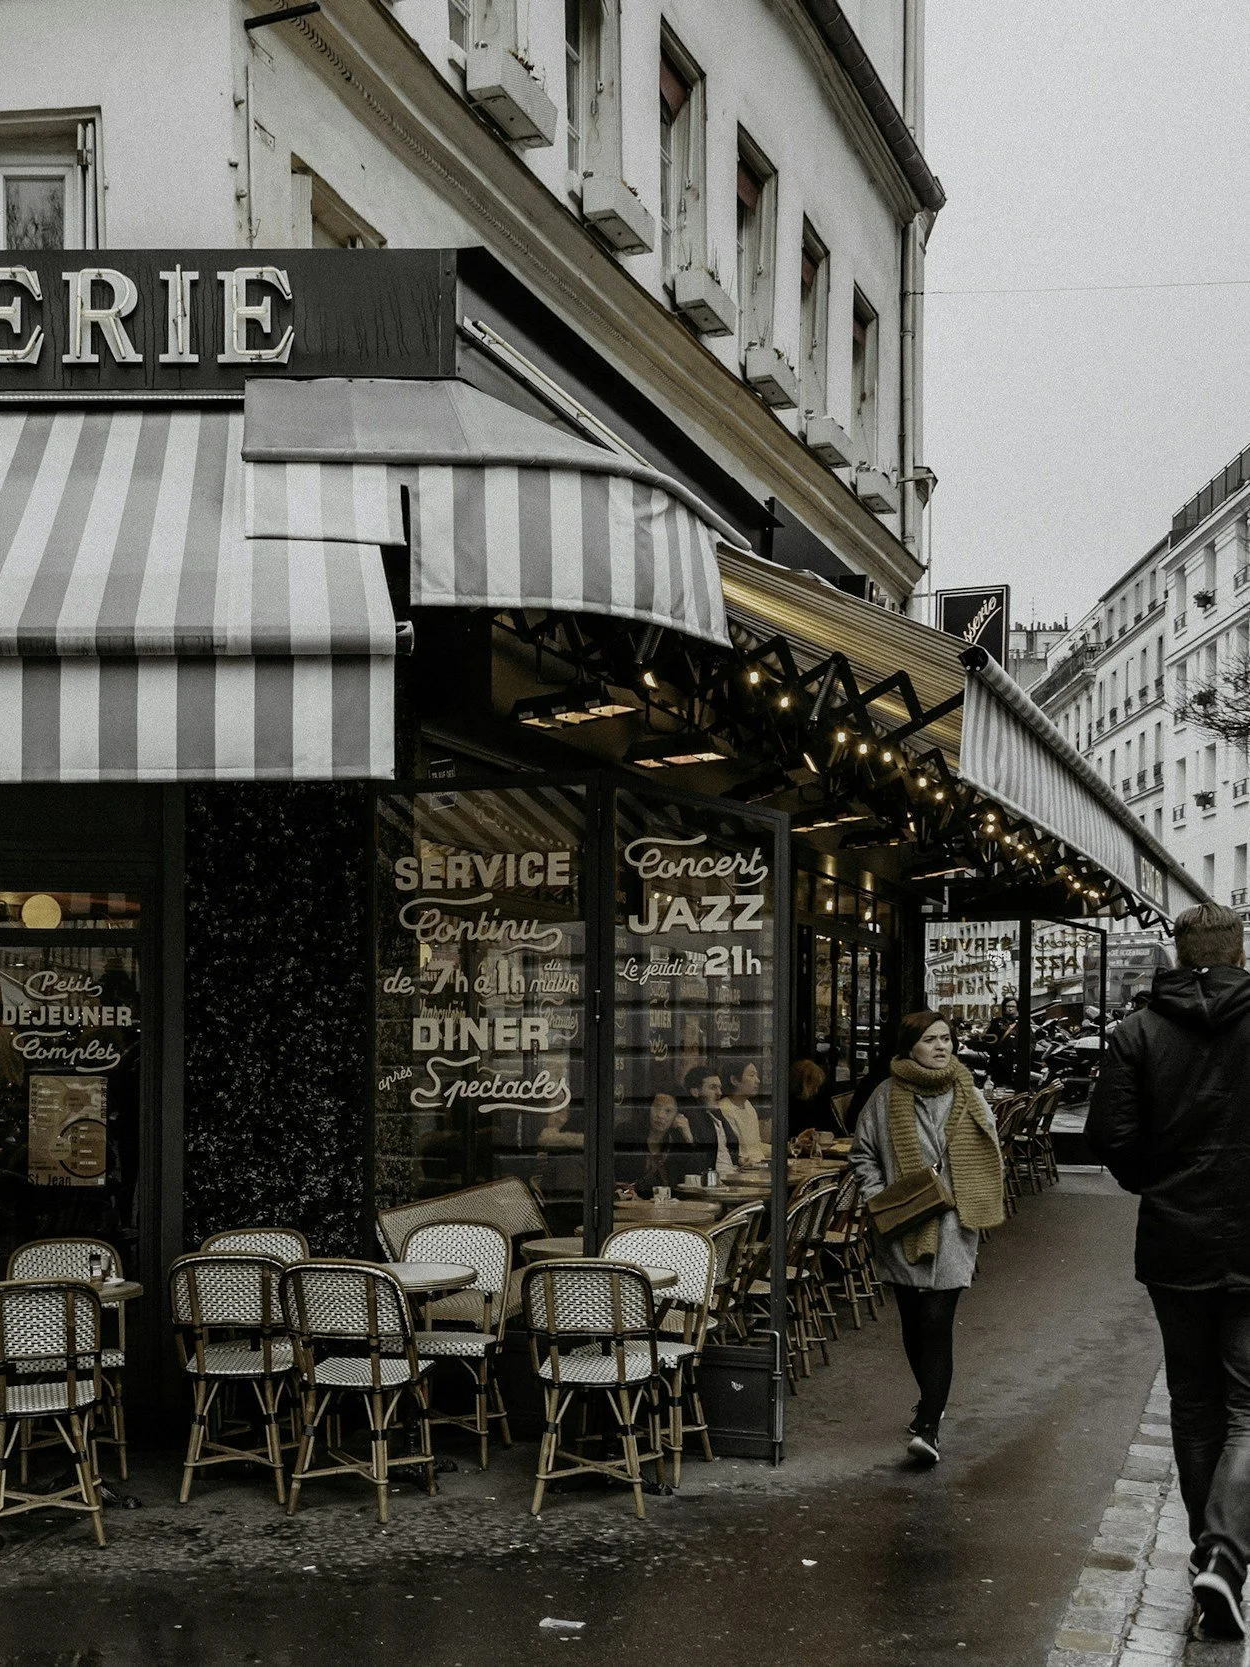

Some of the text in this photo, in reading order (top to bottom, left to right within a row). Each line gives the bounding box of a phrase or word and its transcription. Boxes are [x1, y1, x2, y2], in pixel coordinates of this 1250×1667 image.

[963, 596, 997, 643] sserie
[394, 851, 571, 891] SERVICE
[624, 834, 769, 887] Concert
[399, 892, 563, 955] Continu
[628, 894, 765, 934] JAZZ
[383, 967, 416, 995] de
[426, 959, 469, 994] 7h
[496, 960, 526, 994] 1h
[544, 959, 562, 971] du
[618, 957, 639, 982] Le
[640, 957, 683, 985] jeudi
[704, 945, 762, 976] 21h
[24, 971, 102, 1000] Petit
[529, 978, 579, 994] matin
[12, 1030, 120, 1072] Complet
[412, 1017, 549, 1051] DINER
[378, 1056, 571, 1113] après Spectacles
